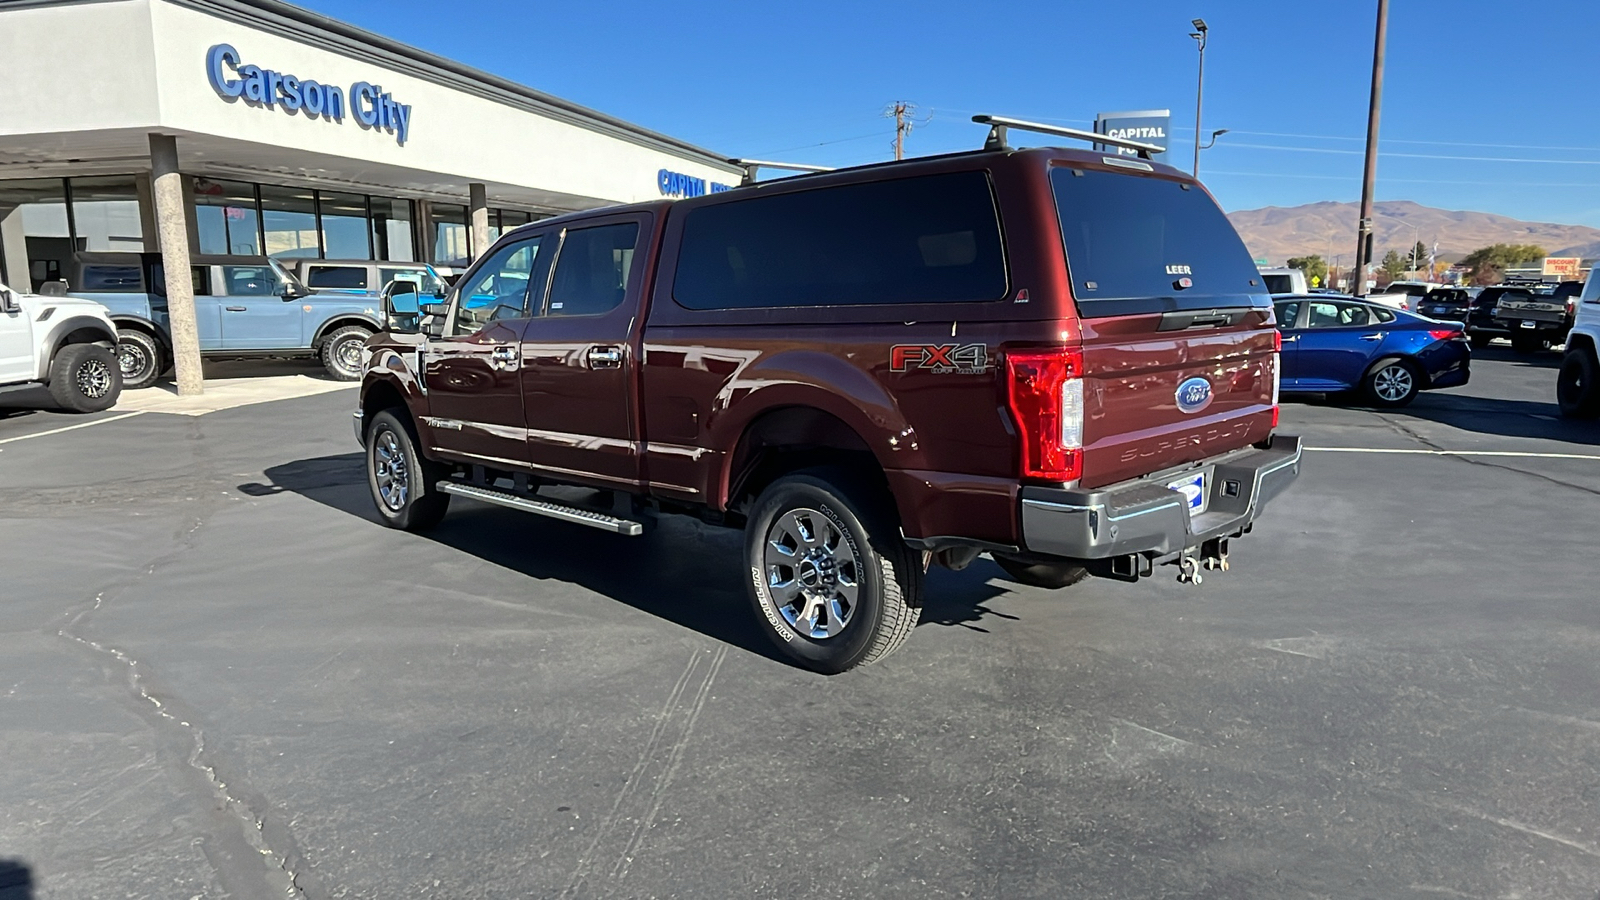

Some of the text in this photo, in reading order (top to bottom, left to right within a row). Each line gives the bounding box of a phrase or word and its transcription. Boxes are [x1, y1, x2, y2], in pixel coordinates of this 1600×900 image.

[206, 43, 412, 147] Carson City
[1108, 127, 1166, 139] CAPITAL
[1165, 265, 1192, 275] LEER
[890, 344, 987, 372] FX4
[751, 566, 794, 643] MICHELIN
